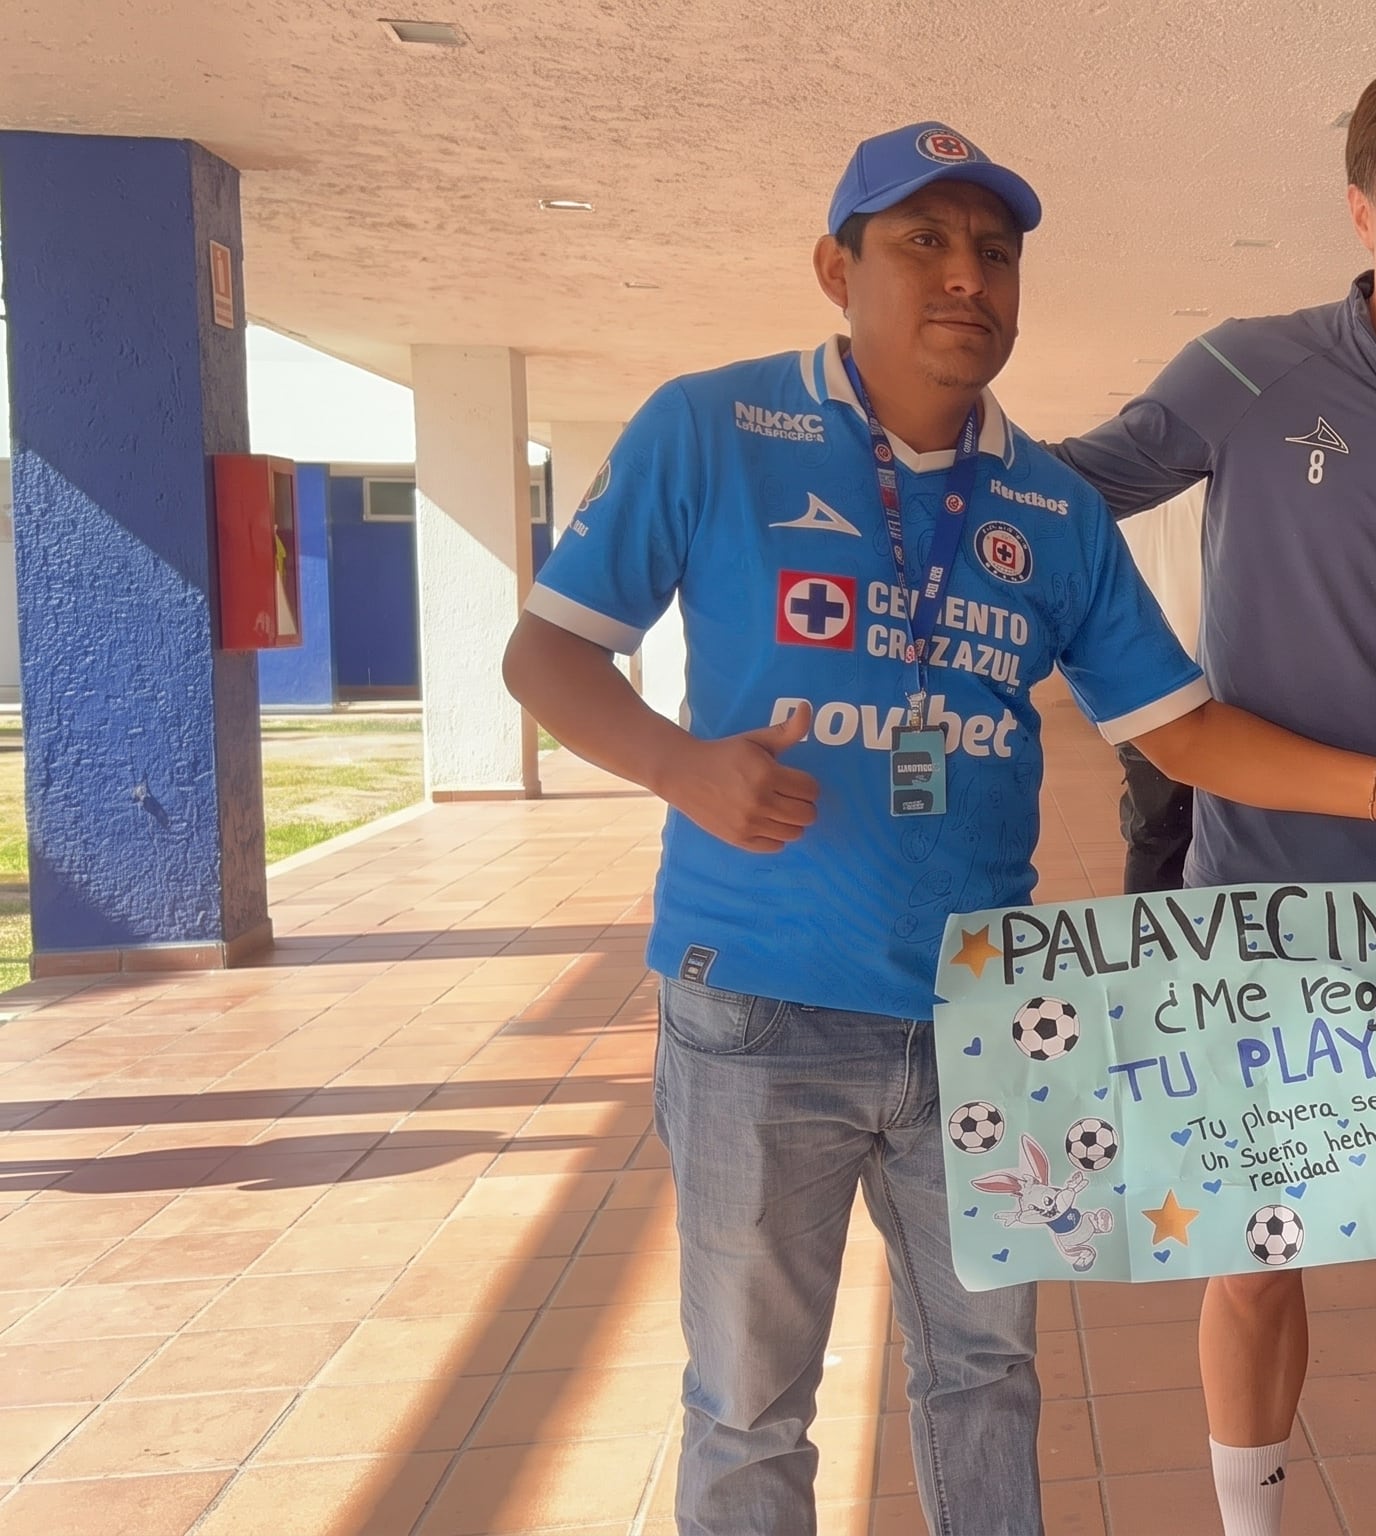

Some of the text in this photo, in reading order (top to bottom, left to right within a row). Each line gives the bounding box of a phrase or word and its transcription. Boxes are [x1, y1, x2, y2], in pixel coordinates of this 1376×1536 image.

[1307, 449, 1325, 484] 8
[867, 623, 1021, 687] CRZ AZUL
[769, 694, 1018, 758] novbet
[1108, 1051, 1198, 1101] TU
[1187, 1116, 1227, 1141] Tu
[1241, 1103, 1339, 1144] playera
[1201, 1151, 1229, 1172] Un
[1249, 1153, 1340, 1192] realidad
